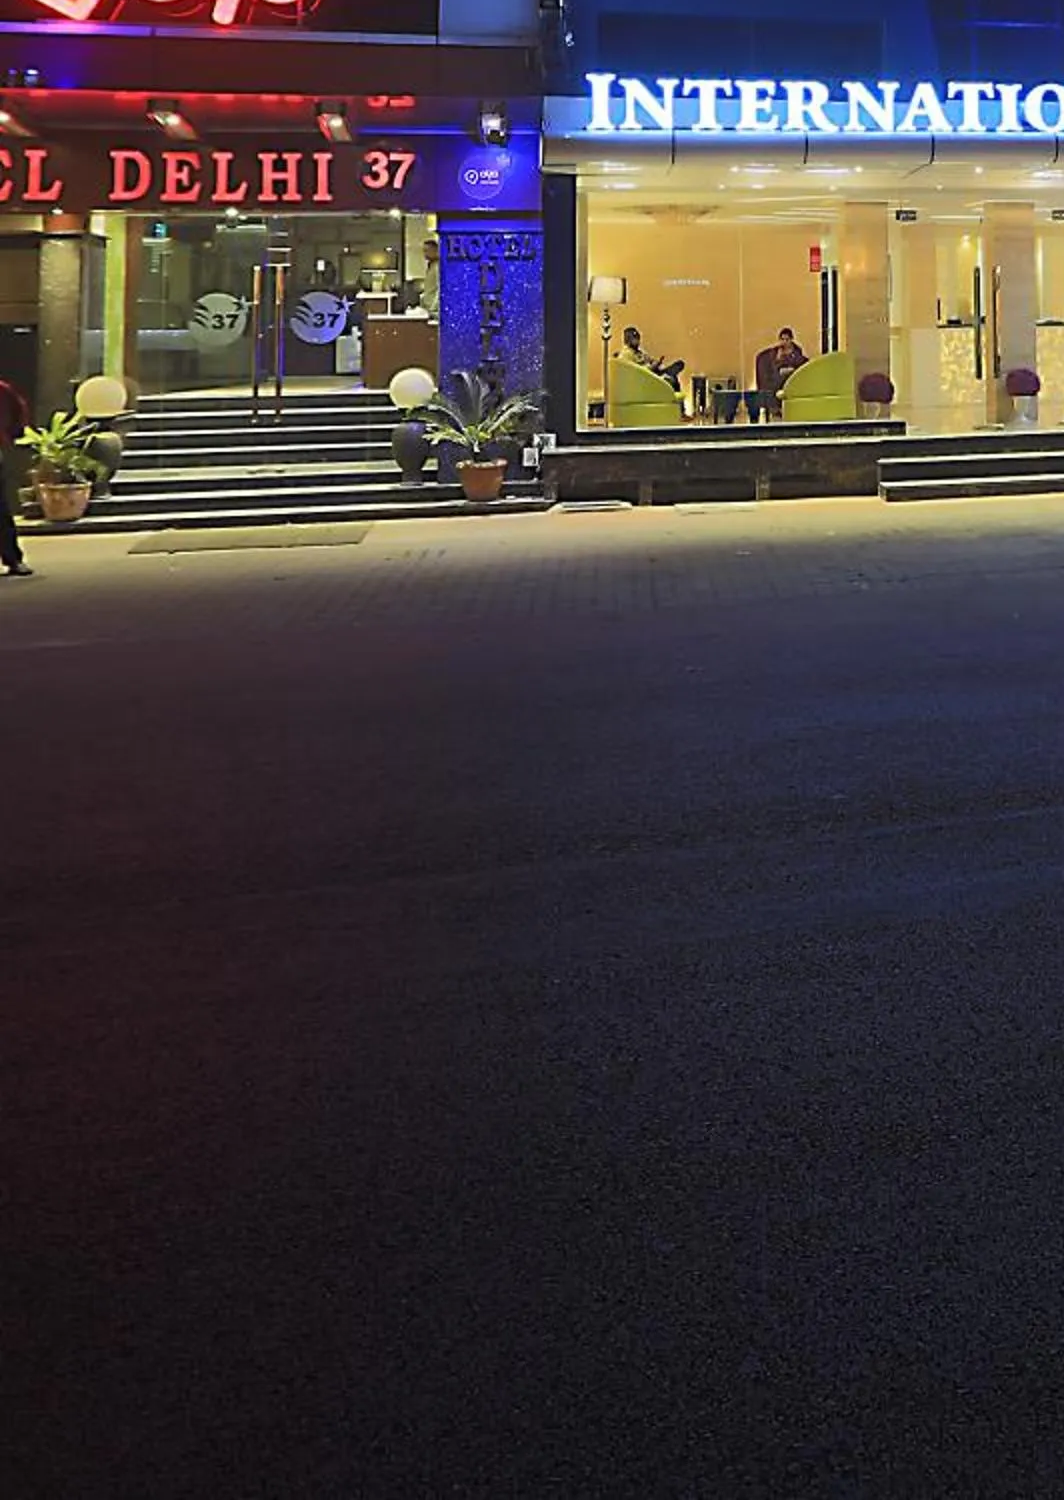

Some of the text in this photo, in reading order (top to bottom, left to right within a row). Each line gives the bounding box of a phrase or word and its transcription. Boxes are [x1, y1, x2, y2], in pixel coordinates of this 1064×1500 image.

[109, 151, 334, 202] DELHI
[362, 151, 416, 190] 37
[447, 234, 536, 261] HOTEL
[211, 314, 239, 329] 37
[313, 312, 340, 328] 37
